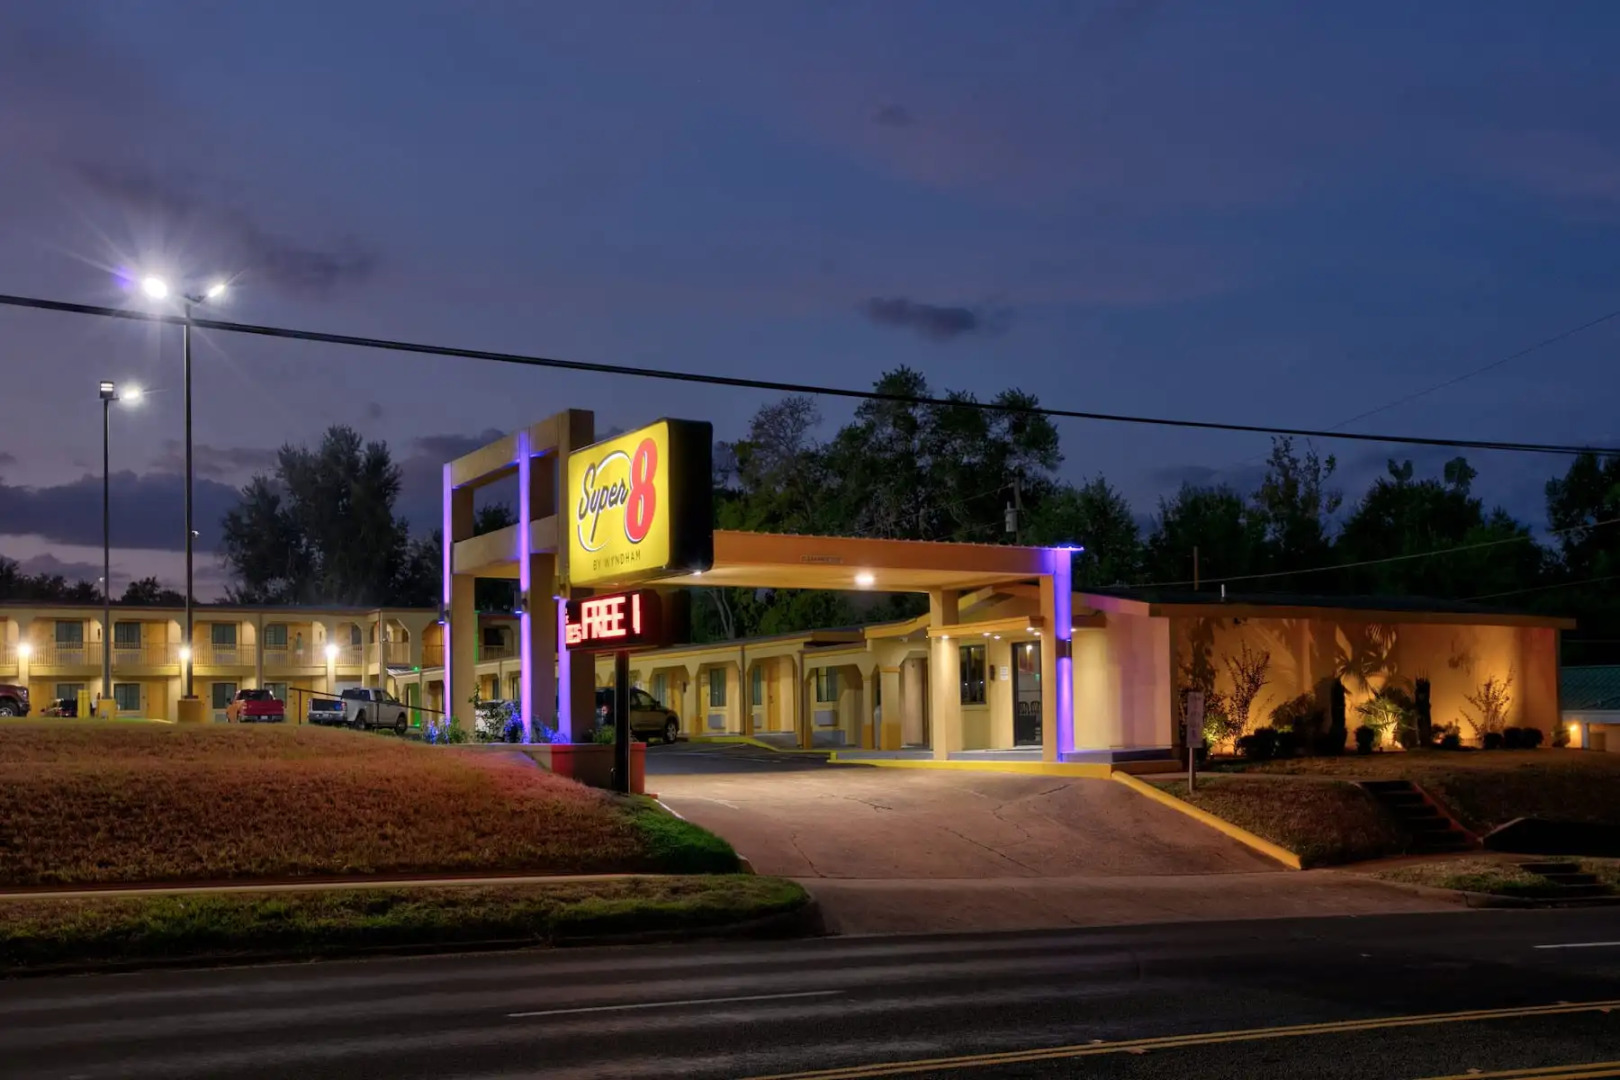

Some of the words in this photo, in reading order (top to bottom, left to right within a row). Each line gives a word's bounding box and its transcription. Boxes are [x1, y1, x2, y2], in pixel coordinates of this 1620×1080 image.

[578, 462, 628, 543] Super
[625, 438, 658, 543] 8
[593, 559, 601, 571] BY
[604, 549, 641, 568] WYNDHAM
[581, 596, 626, 640] FREE
